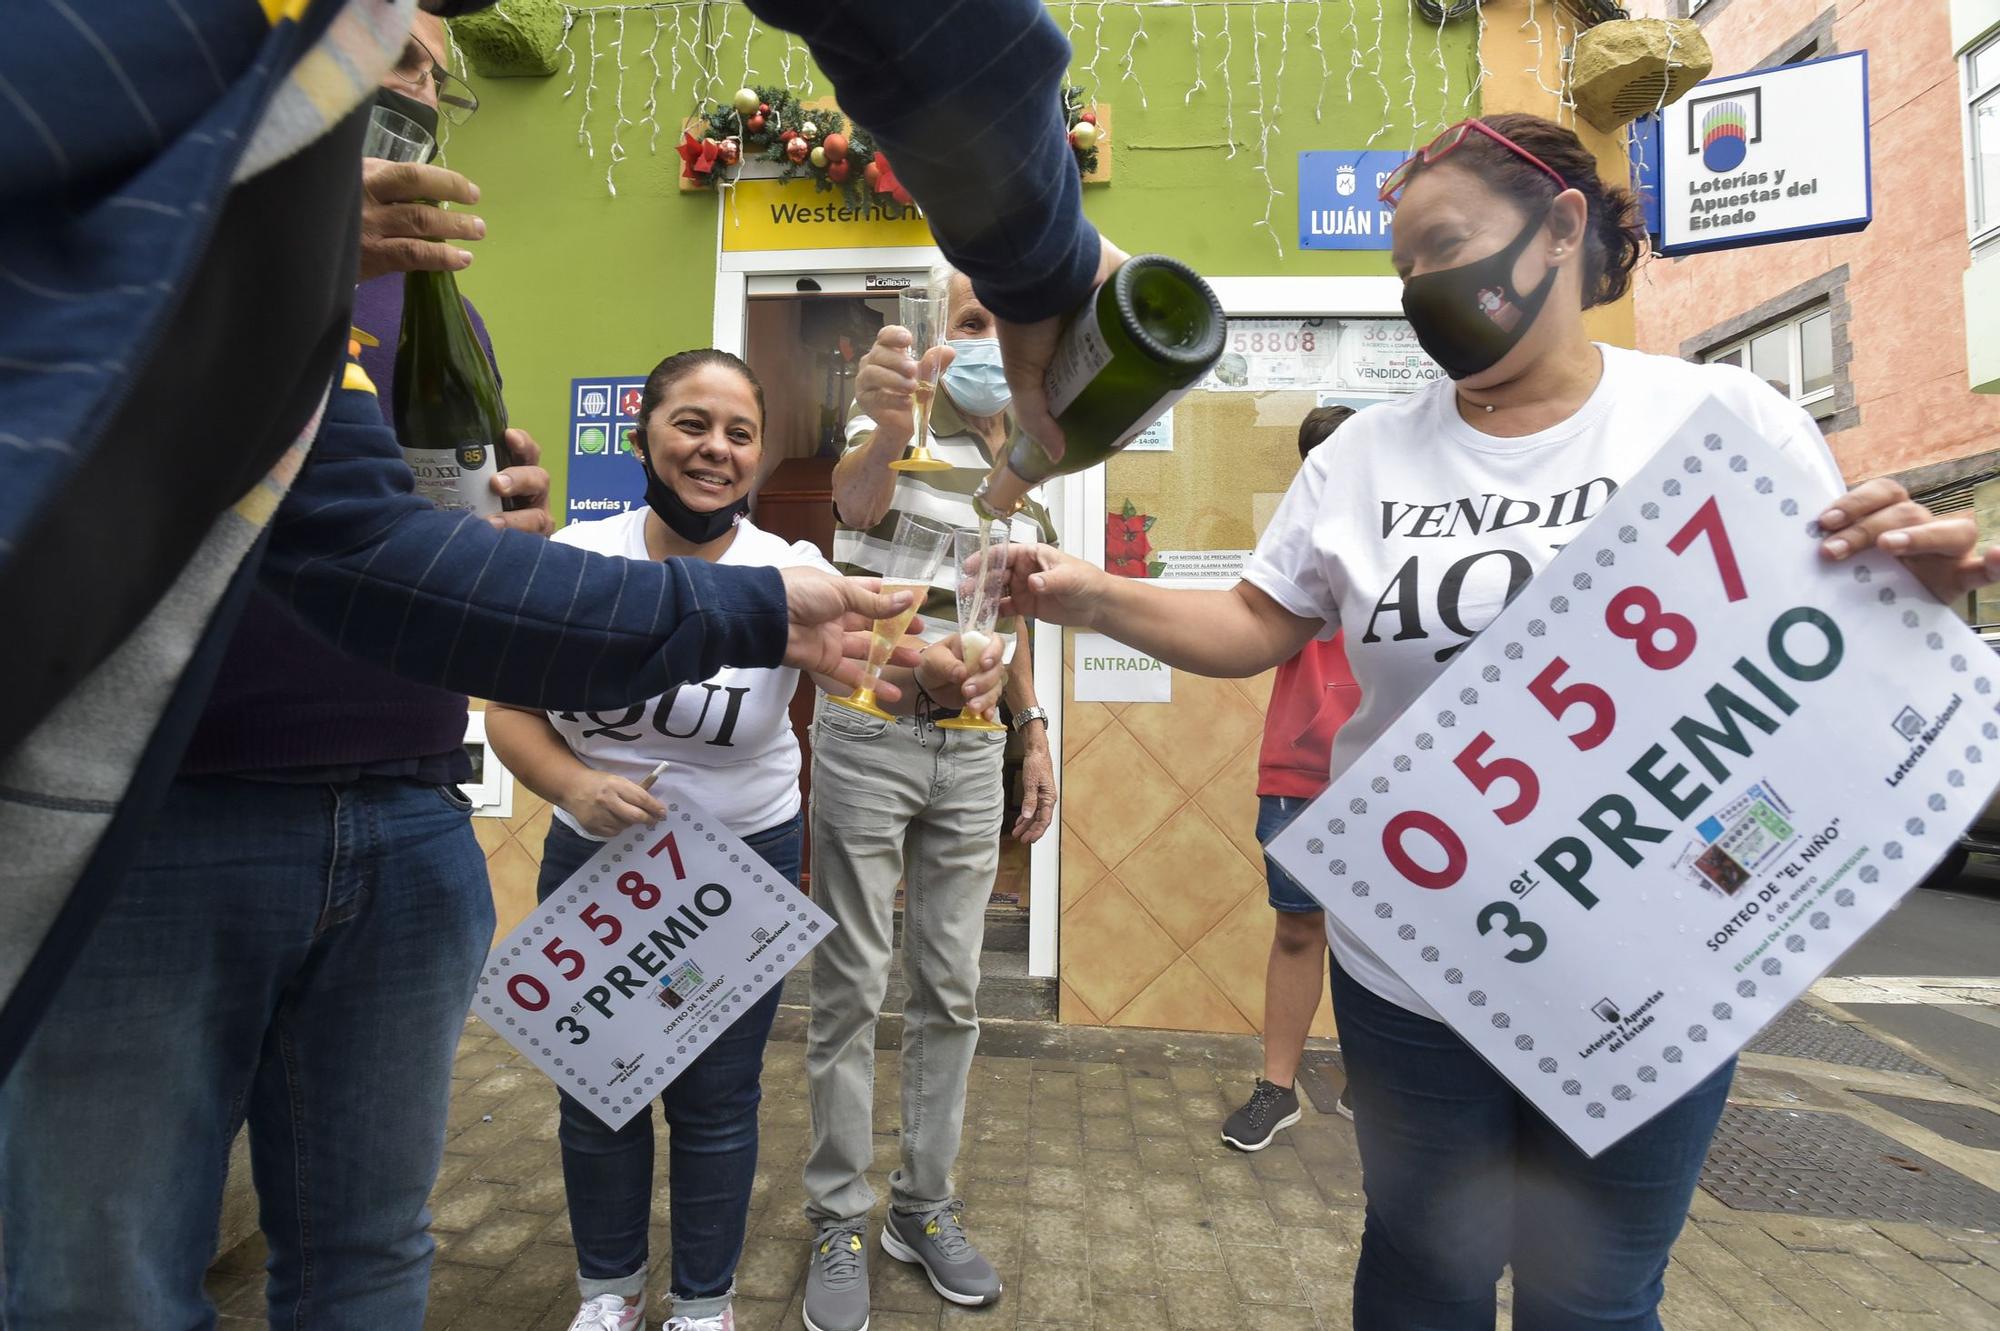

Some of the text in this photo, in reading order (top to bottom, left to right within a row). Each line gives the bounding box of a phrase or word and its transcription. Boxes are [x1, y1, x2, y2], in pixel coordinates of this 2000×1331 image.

[1689, 169, 1786, 196] Loterías y
[1690, 178, 1817, 214] Apuestas del
[1311, 205, 1371, 235] LUJÁN
[1689, 208, 1756, 231] Estado
[1356, 367, 1412, 379] VENDIDO
[570, 498, 631, 512] Loterías y
[1380, 476, 1619, 539] VENDID
[1362, 546, 1550, 663] AQ
[1084, 657, 1162, 671] ENTRADA
[552, 682, 751, 748] QUI
[1921, 692, 1963, 746] Nacional
[1534, 606, 1844, 911] PREMIO
[1706, 817, 1840, 952] SORTEO DE "EL NIÑO"
[1766, 875, 1818, 923] 6 de enero
[766, 920, 791, 945] Nacional
[1767, 929, 1781, 942] De
[1779, 920, 1790, 932] La
[1787, 897, 1814, 923] Suerte
[582, 883, 732, 1019] PREMIO
[663, 1011, 689, 1035] SORTEO
[687, 1002, 698, 1012] DE
[1616, 1024, 1625, 1033] y
[1623, 990, 1664, 1026] Apuestas
[1609, 1015, 1655, 1053] del Estado
